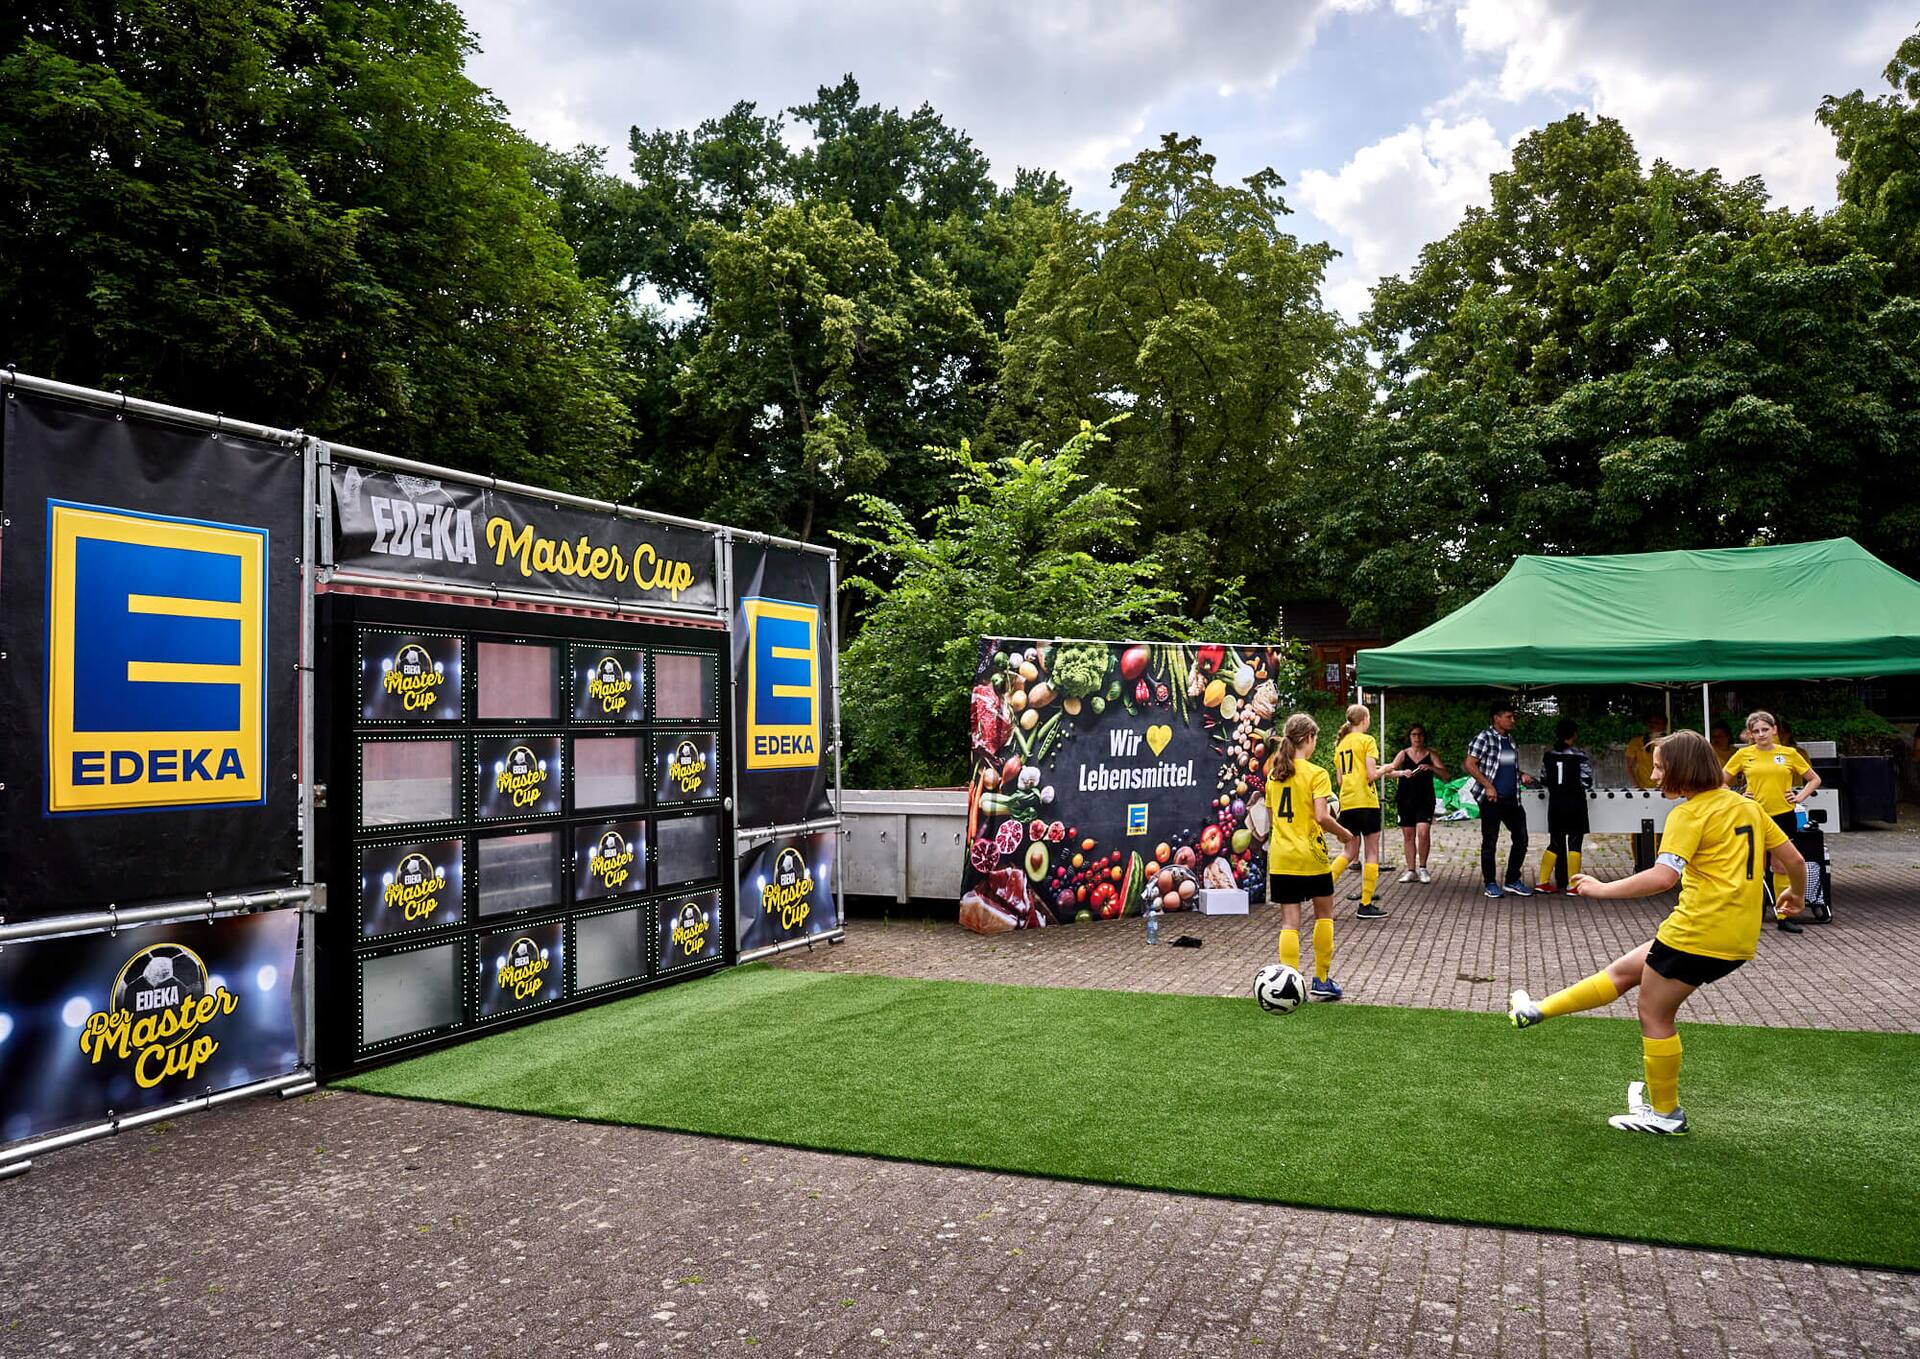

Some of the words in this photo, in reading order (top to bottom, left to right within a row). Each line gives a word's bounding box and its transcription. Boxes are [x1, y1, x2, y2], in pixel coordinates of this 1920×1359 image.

[370, 495, 477, 566] EDEKA
[486, 515, 630, 583] Master
[633, 543, 695, 601] Cup
[384, 671, 444, 694] Master
[589, 679, 632, 699] Master
[404, 691, 437, 711] Cup
[603, 696, 627, 713] Cup
[755, 735, 814, 755] EDEKA
[1110, 729, 1142, 757] Wir
[71, 748, 246, 787] EDEKA
[669, 761, 706, 781] Master
[1339, 749, 1354, 776] 17
[1556, 762, 1564, 784] 1
[497, 769, 547, 793] Master
[681, 777, 702, 792] Cup
[1078, 760, 1198, 792] Lebensmittel.
[513, 788, 541, 807] Cup
[1278, 787, 1295, 823] 4
[590, 852, 634, 876] Master
[1734, 824, 1755, 880] 7
[604, 869, 629, 888] Cup
[384, 876, 446, 907] Master
[763, 875, 815, 914] Master
[405, 898, 439, 921] Cup
[782, 902, 810, 930] Cup
[672, 921, 709, 945] Master
[684, 937, 706, 955] Cup
[498, 957, 550, 988] Master
[136, 985, 179, 1012] EDEKA
[515, 978, 543, 1000] Cup
[80, 986, 239, 1064] Master
[87, 1007, 133, 1037] Der
[134, 1034, 219, 1088] Cup
